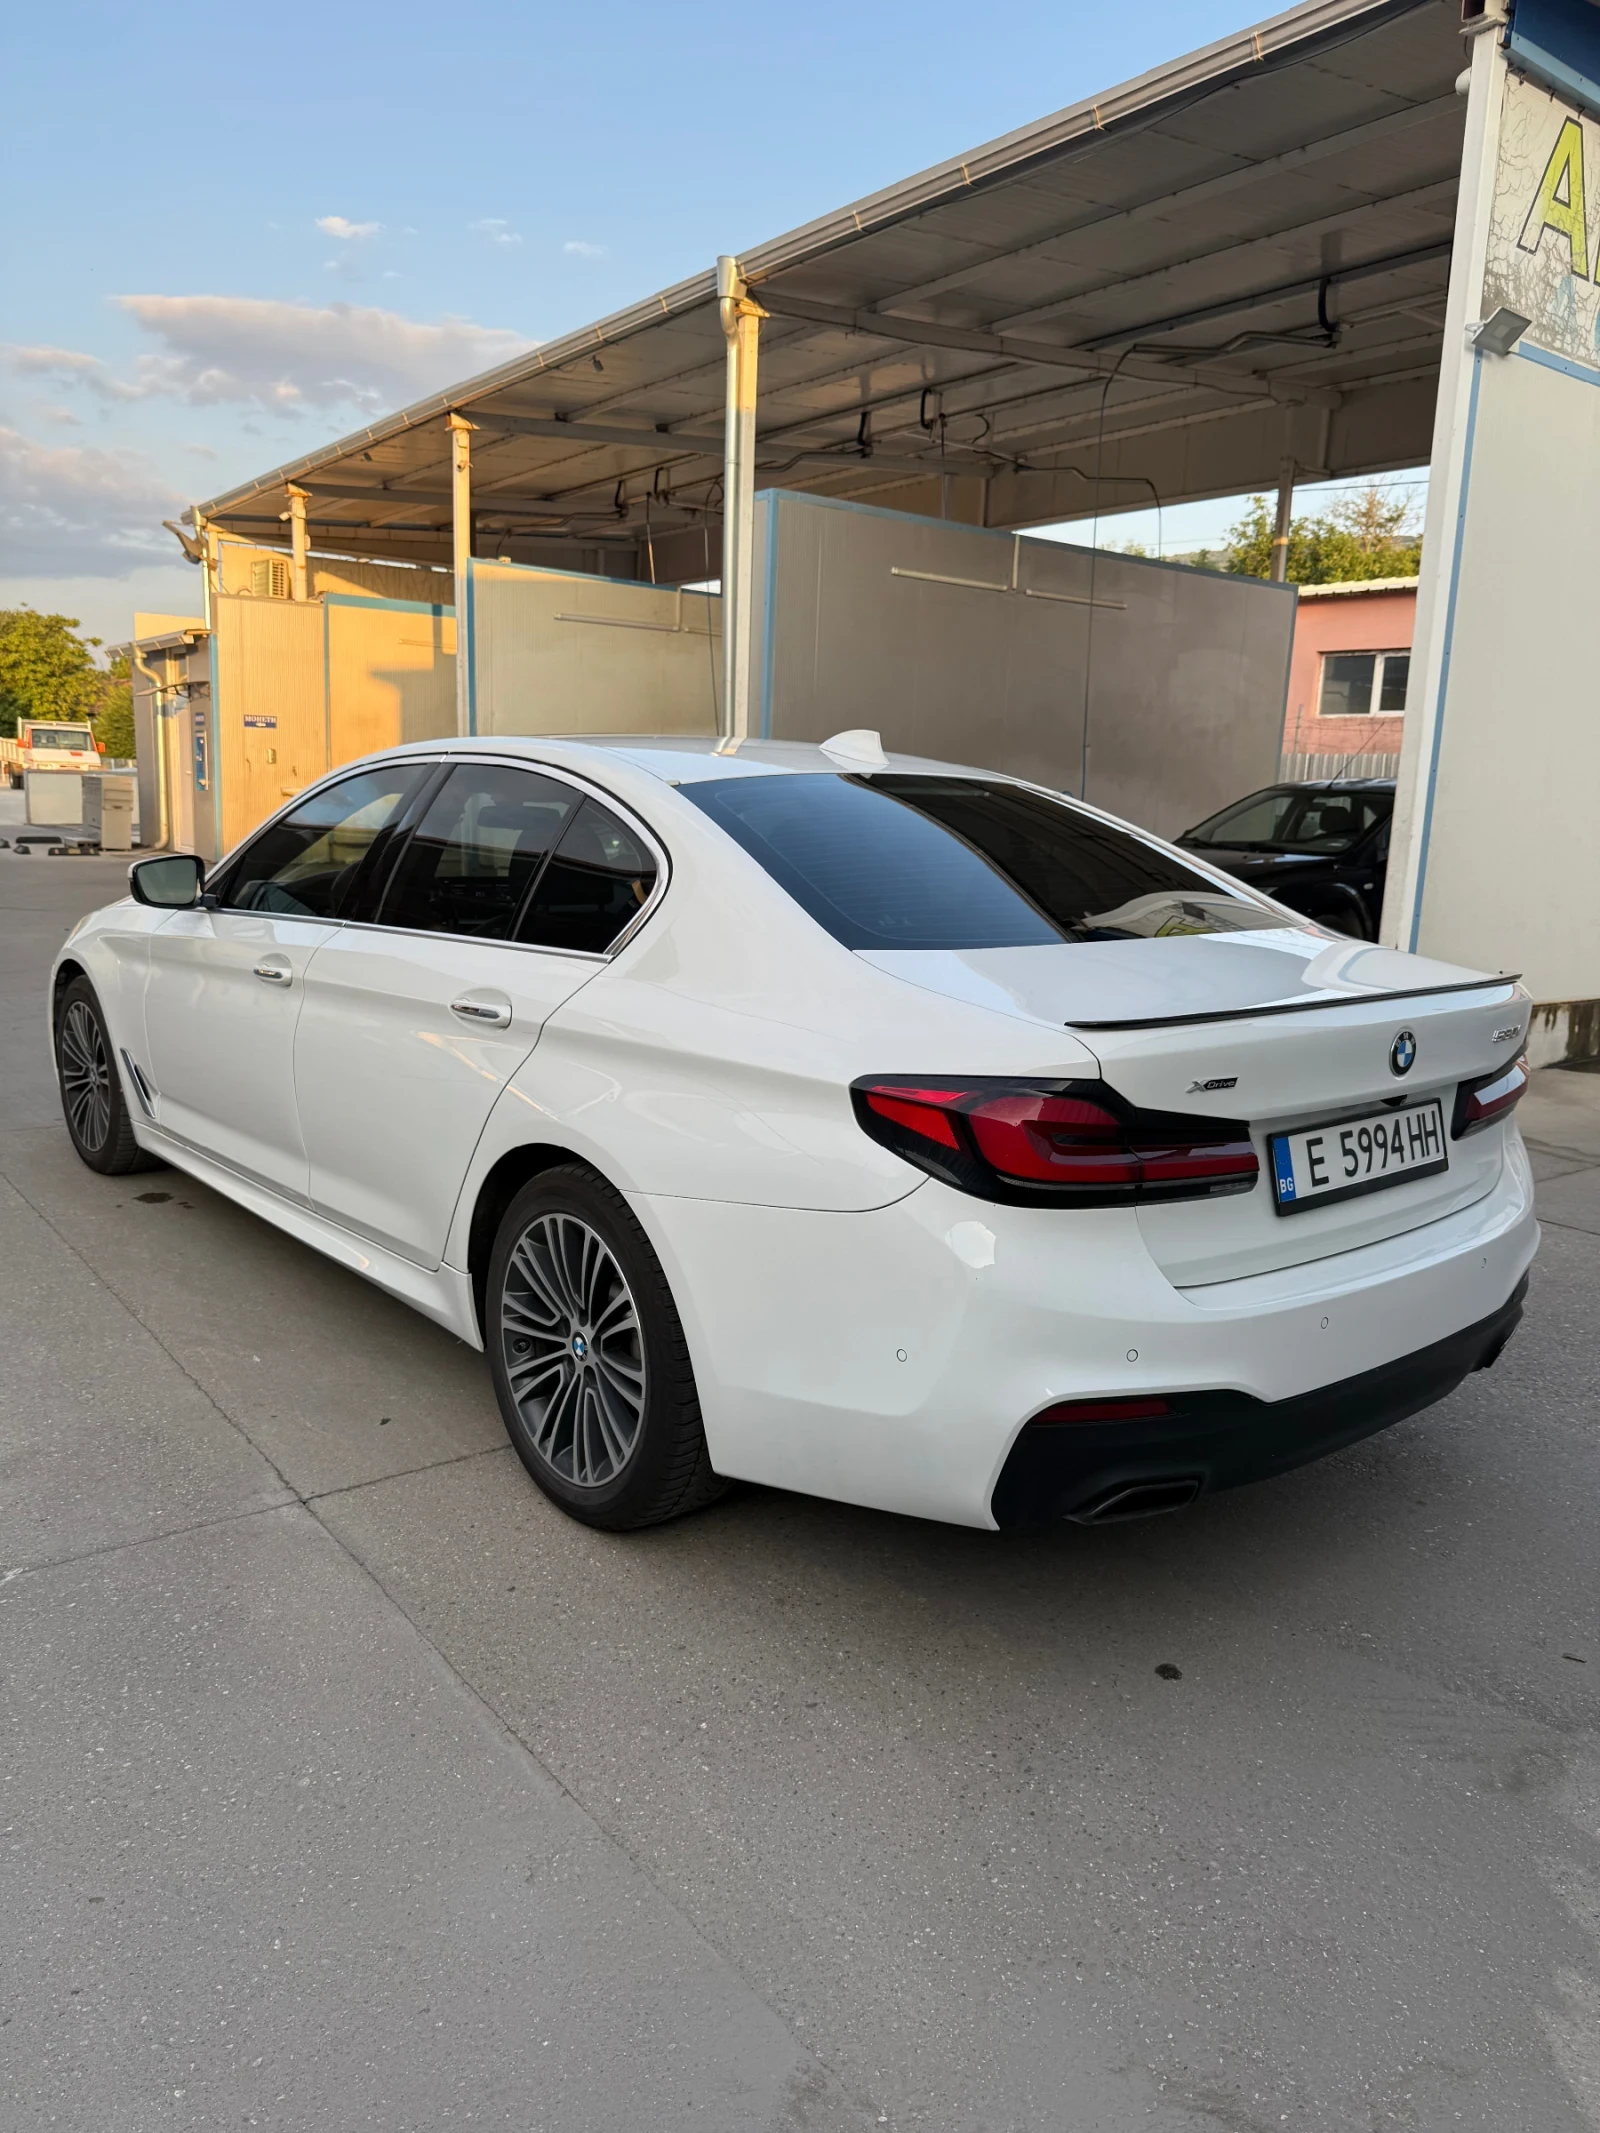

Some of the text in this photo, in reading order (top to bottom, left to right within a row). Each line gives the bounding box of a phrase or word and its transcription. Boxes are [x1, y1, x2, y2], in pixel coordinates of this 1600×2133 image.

[1517, 115, 1600, 287] А
[1279, 1177, 1294, 1194] BG
[1306, 1137, 1329, 1188] E
